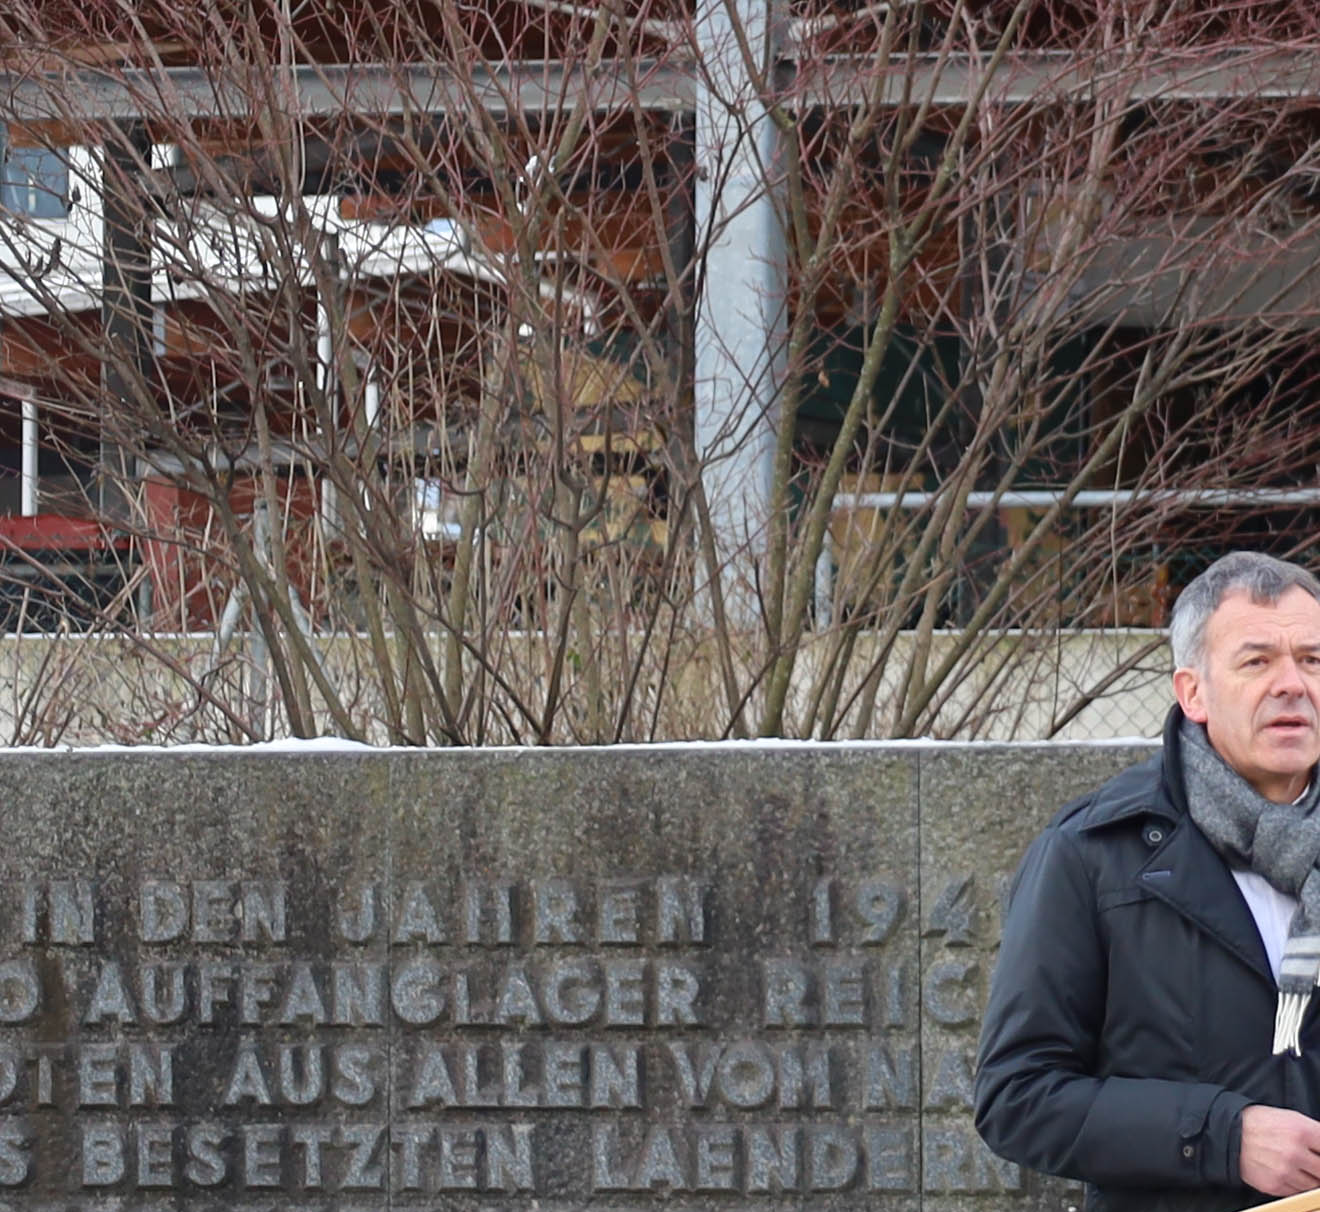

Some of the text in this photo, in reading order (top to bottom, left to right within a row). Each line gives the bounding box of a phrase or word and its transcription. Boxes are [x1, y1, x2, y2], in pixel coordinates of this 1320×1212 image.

[21, 873, 1009, 948] IN DEN JAHREN 194
[84, 958, 700, 1028] AUFFANGLAGER
[763, 957, 1000, 1029] REIC
[225, 1042, 377, 1106] AUS
[414, 1044, 642, 1108] ALLEN
[82, 1121, 536, 1190] BESETZTEN
[594, 1123, 1022, 1192] LAENDERN
